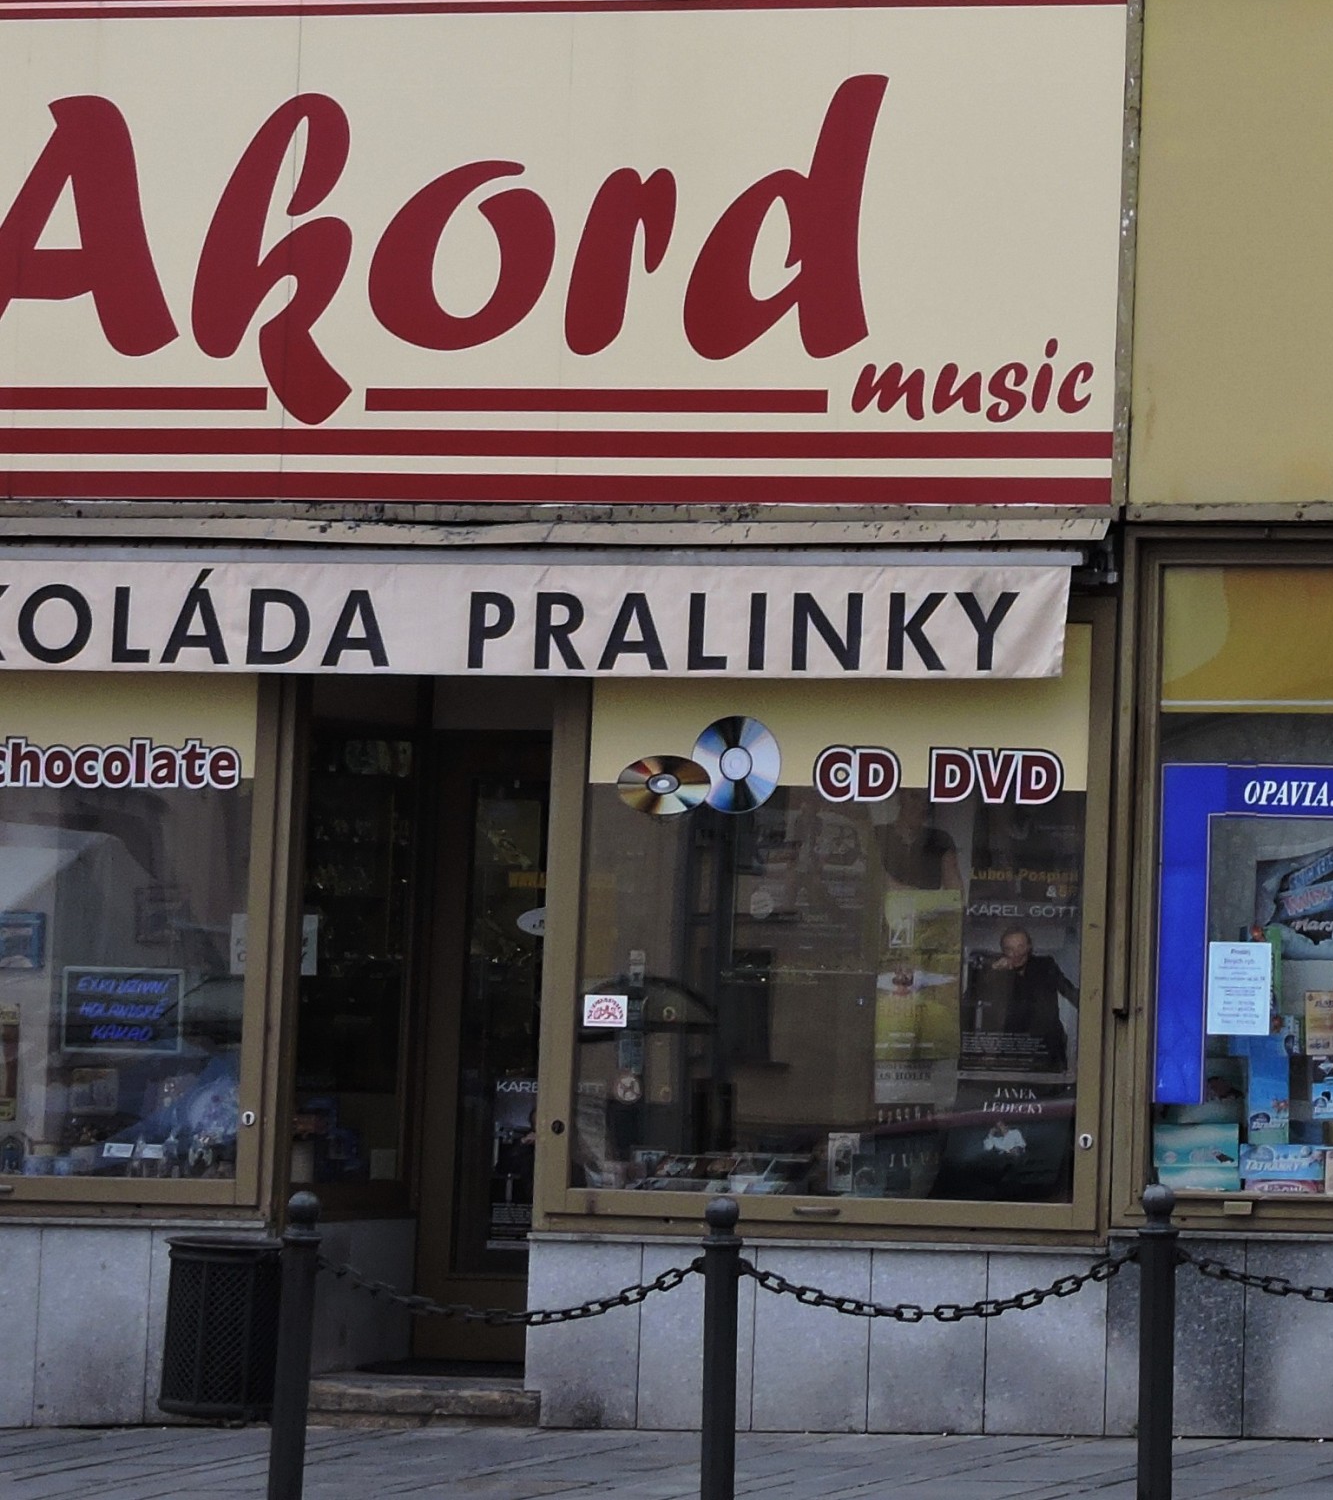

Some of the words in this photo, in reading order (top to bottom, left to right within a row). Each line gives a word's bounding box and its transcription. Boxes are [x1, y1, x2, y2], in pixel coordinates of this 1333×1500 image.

[0, 74, 889, 425] Akord
[851, 338, 1094, 424] music
[467, 588, 1020, 672] PRALINKY
[815, 746, 899, 802] CD
[930, 748, 1063, 804] DVD
[966, 904, 1025, 917] KAREL
[1029, 904, 1078, 918] GOTT
[91, 1023, 154, 1042] KAKAO
[496, 1080, 538, 1092] KARE
